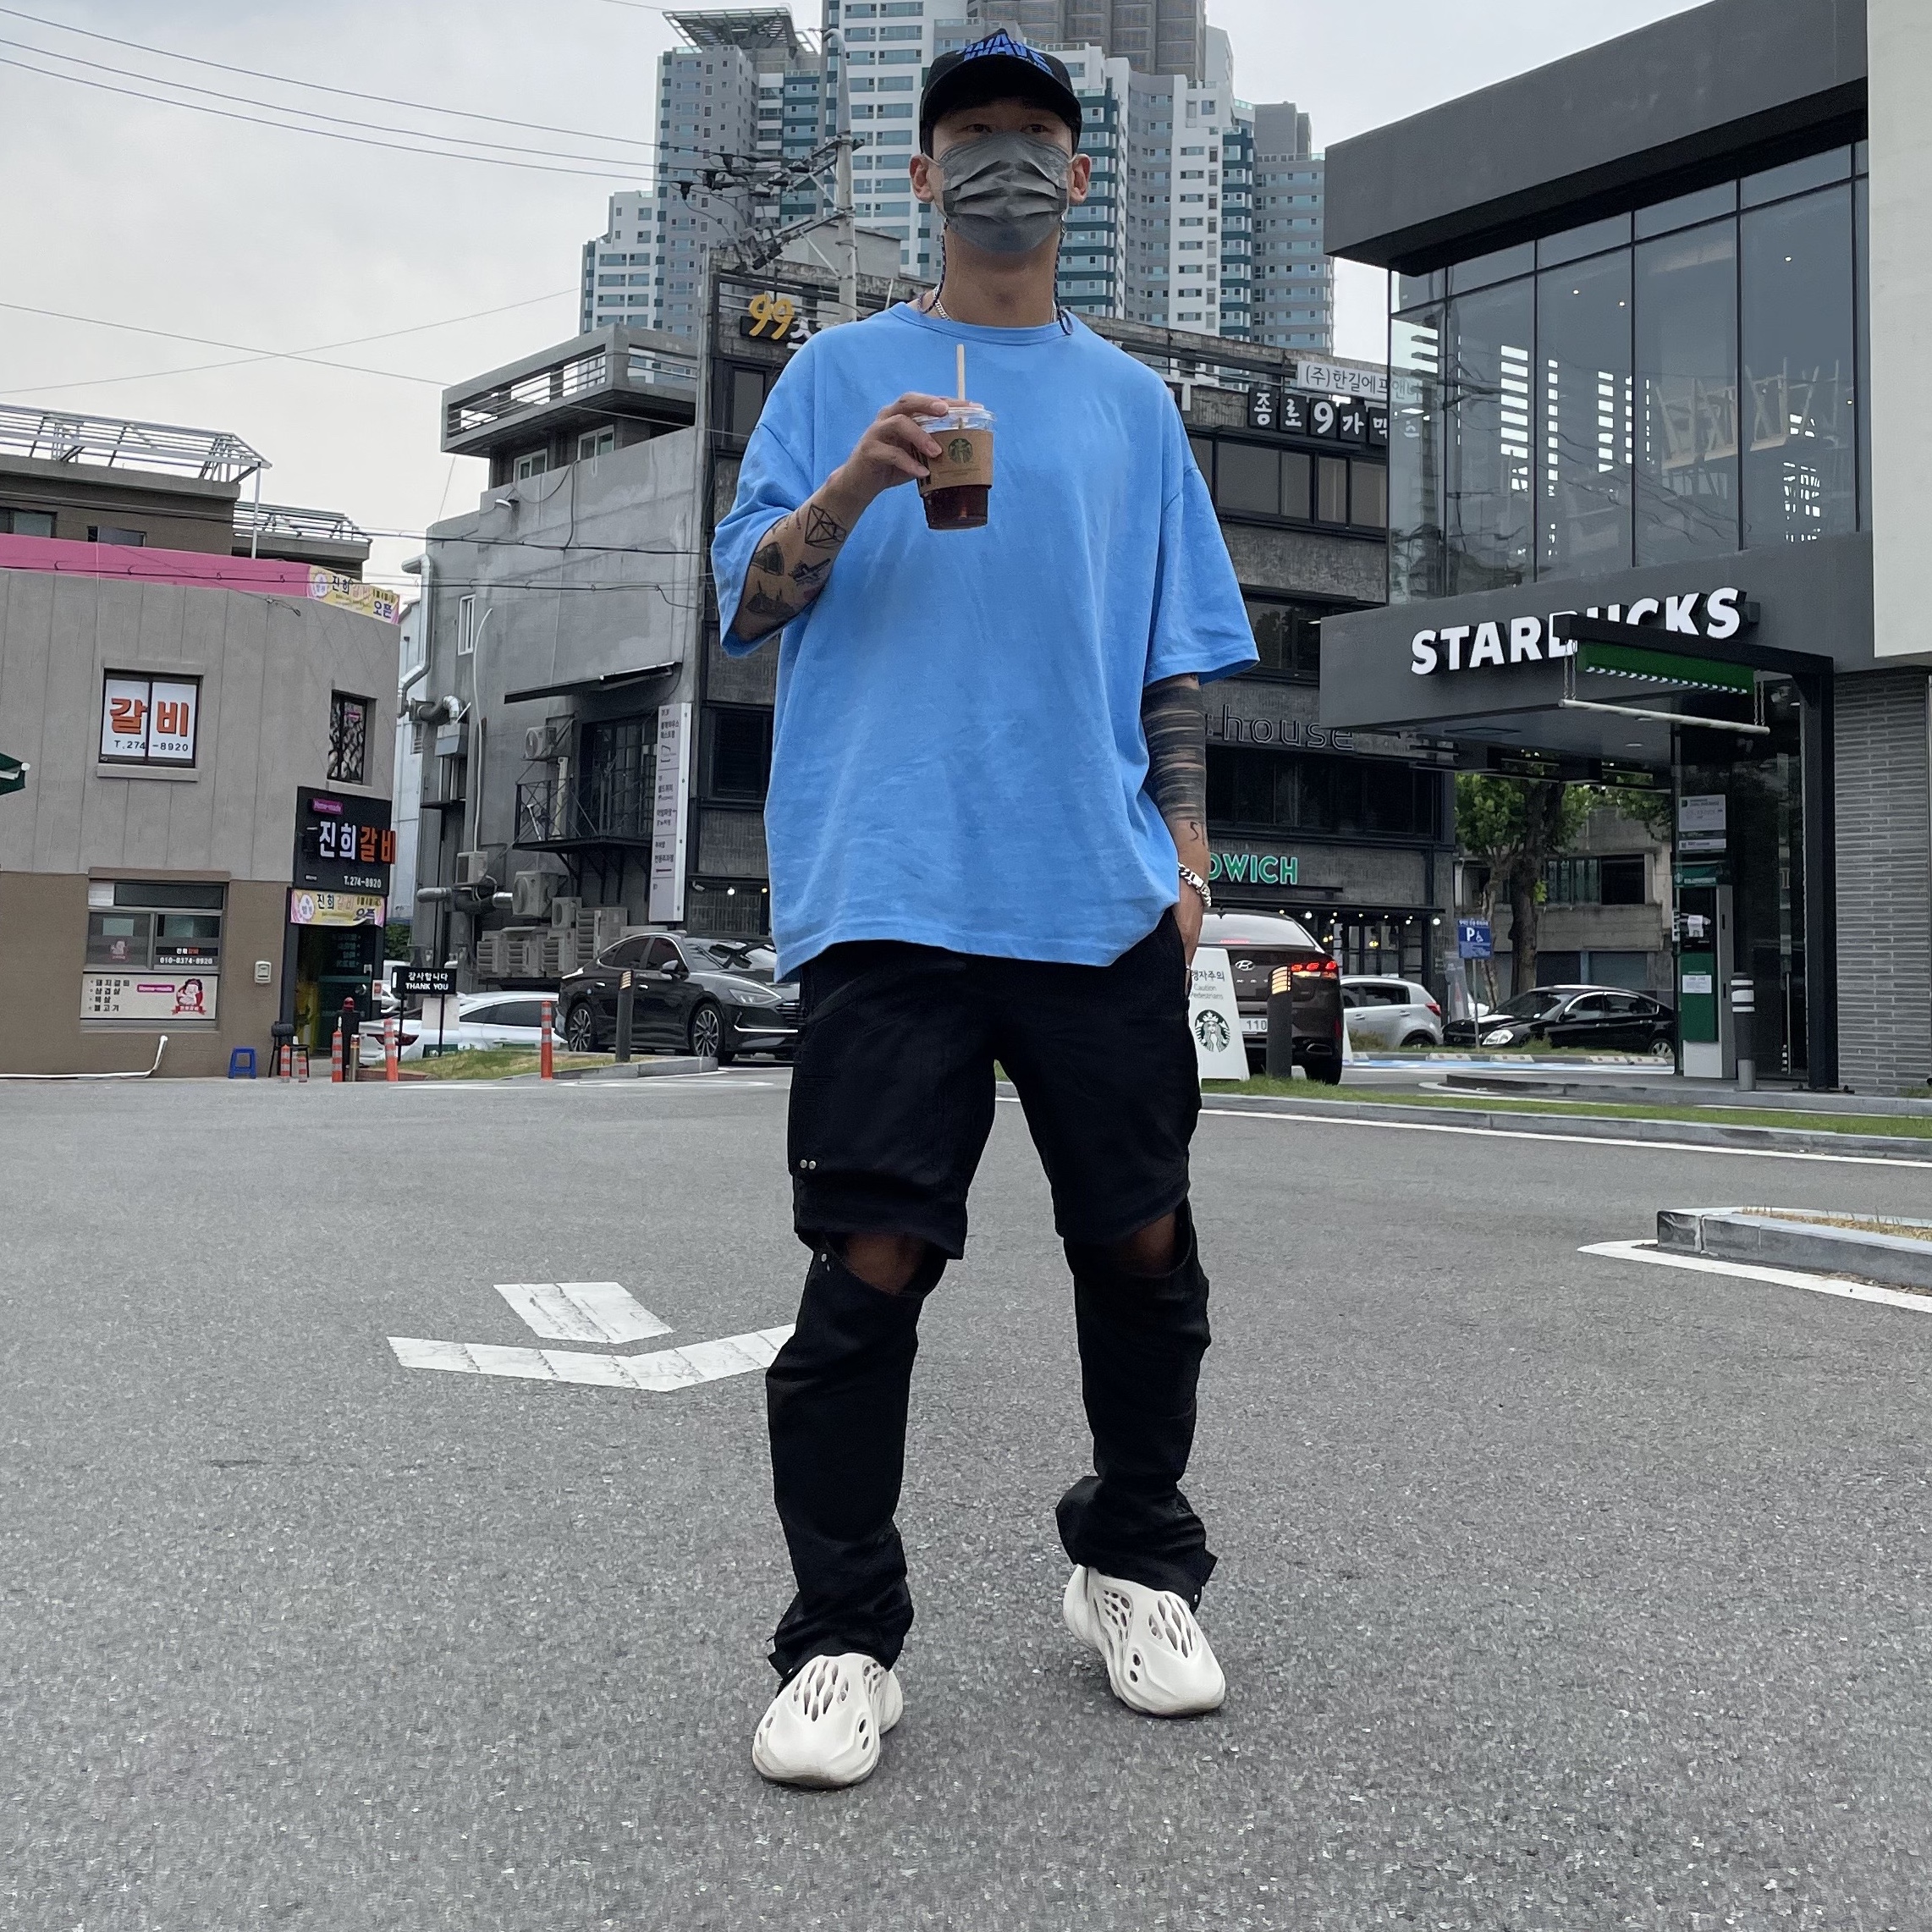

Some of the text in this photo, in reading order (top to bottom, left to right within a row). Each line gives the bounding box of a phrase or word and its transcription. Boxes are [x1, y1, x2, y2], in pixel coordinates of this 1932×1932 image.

[109, 698, 189, 737] 갈비
[114, 740, 188, 751] T.274-8920
[319, 821, 396, 864] 진희갈비
[344, 875, 382, 889] T.274-8920
[1467, 927, 1476, 942] P
[408, 972, 449, 982] 감사합니다
[405, 982, 449, 991] THANK YOU
[1246, 1020, 1268, 1031] 110
